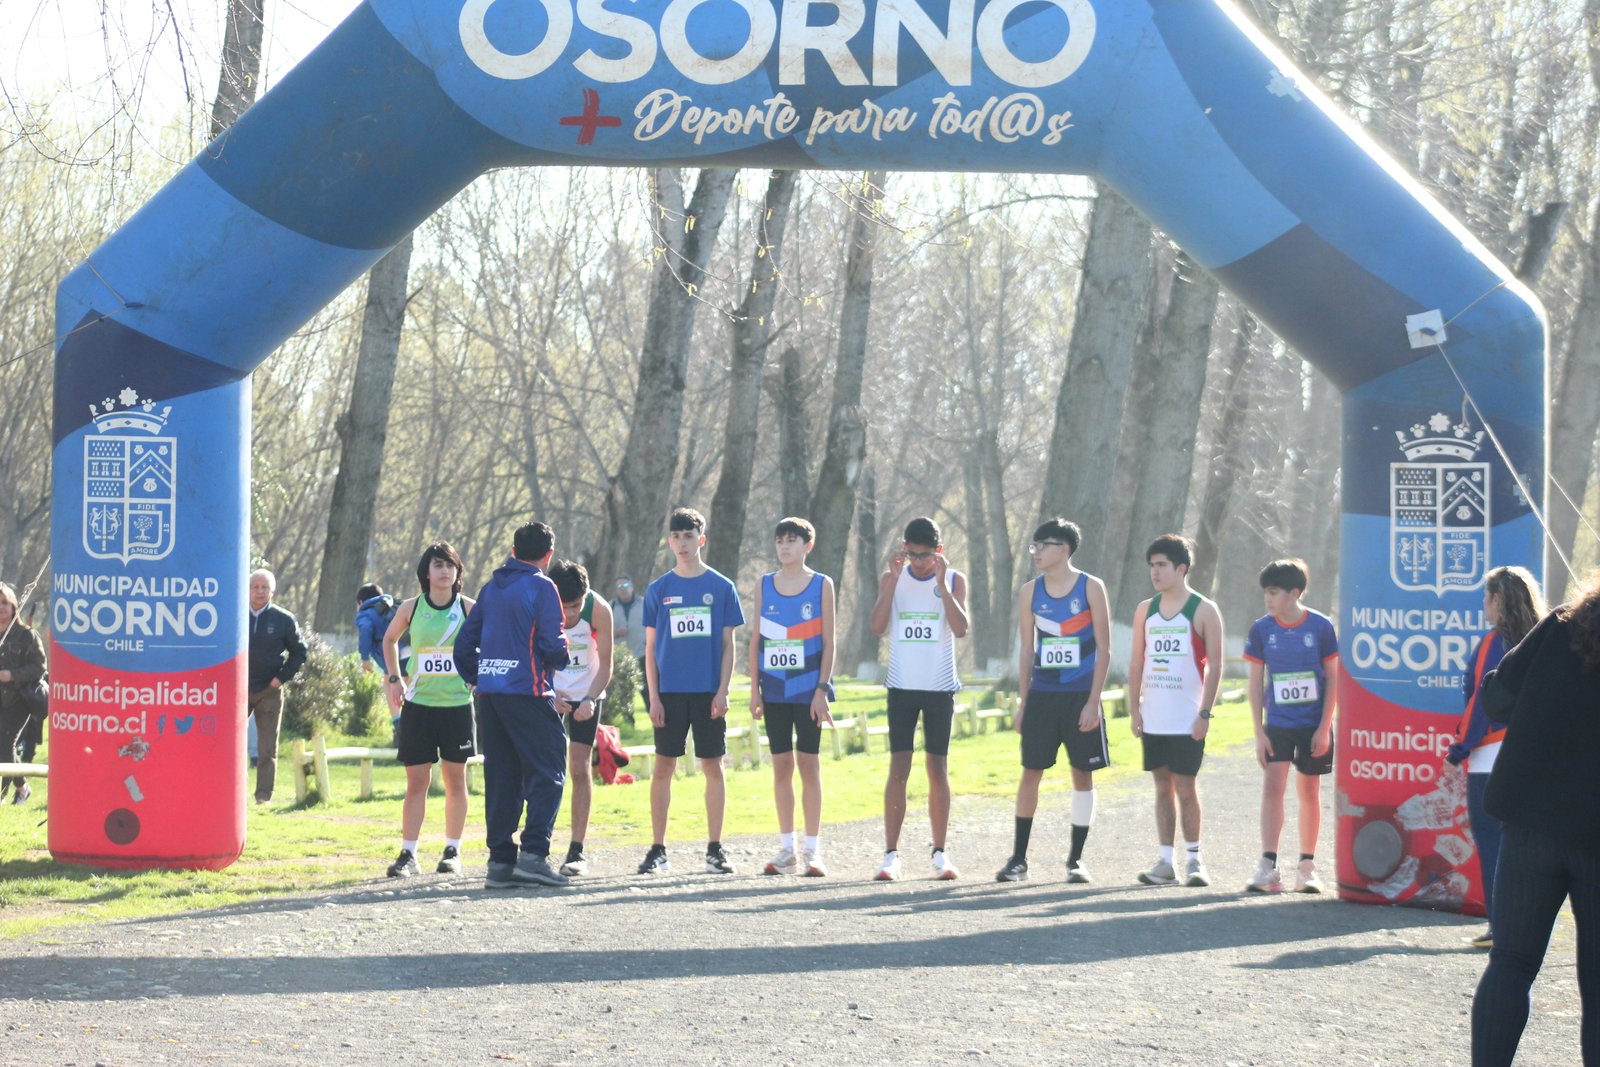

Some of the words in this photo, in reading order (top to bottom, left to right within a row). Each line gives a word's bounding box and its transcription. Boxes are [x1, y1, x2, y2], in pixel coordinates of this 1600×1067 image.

[458, 0, 1097, 88] OSORNO
[633, 87, 800, 144] Deporte
[806, 98, 917, 145] para
[926, 90, 1076, 146] tod@s
[137, 503, 156, 511] FIDE
[131, 547, 159, 555] AMORE
[54, 573, 219, 598] MUNICIPALIDAD
[1444, 577, 1473, 585] AMORE
[53, 598, 219, 637] OSORNO
[1351, 606, 1495, 630] MUNICIPALI
[677, 619, 704, 633] 004
[905, 626, 932, 639] 003
[104, 638, 144, 652] CHILE
[1154, 639, 1180, 652] 002
[770, 653, 797, 667] 006
[1046, 650, 1073, 664] 005
[424, 659, 452, 672] 050
[1417, 675, 1460, 688] CHILE
[52, 678, 218, 710] municipalidad
[1281, 686, 1309, 700] 007
[52, 711, 147, 734] osorno.cl
[1350, 725, 1456, 757] municip
